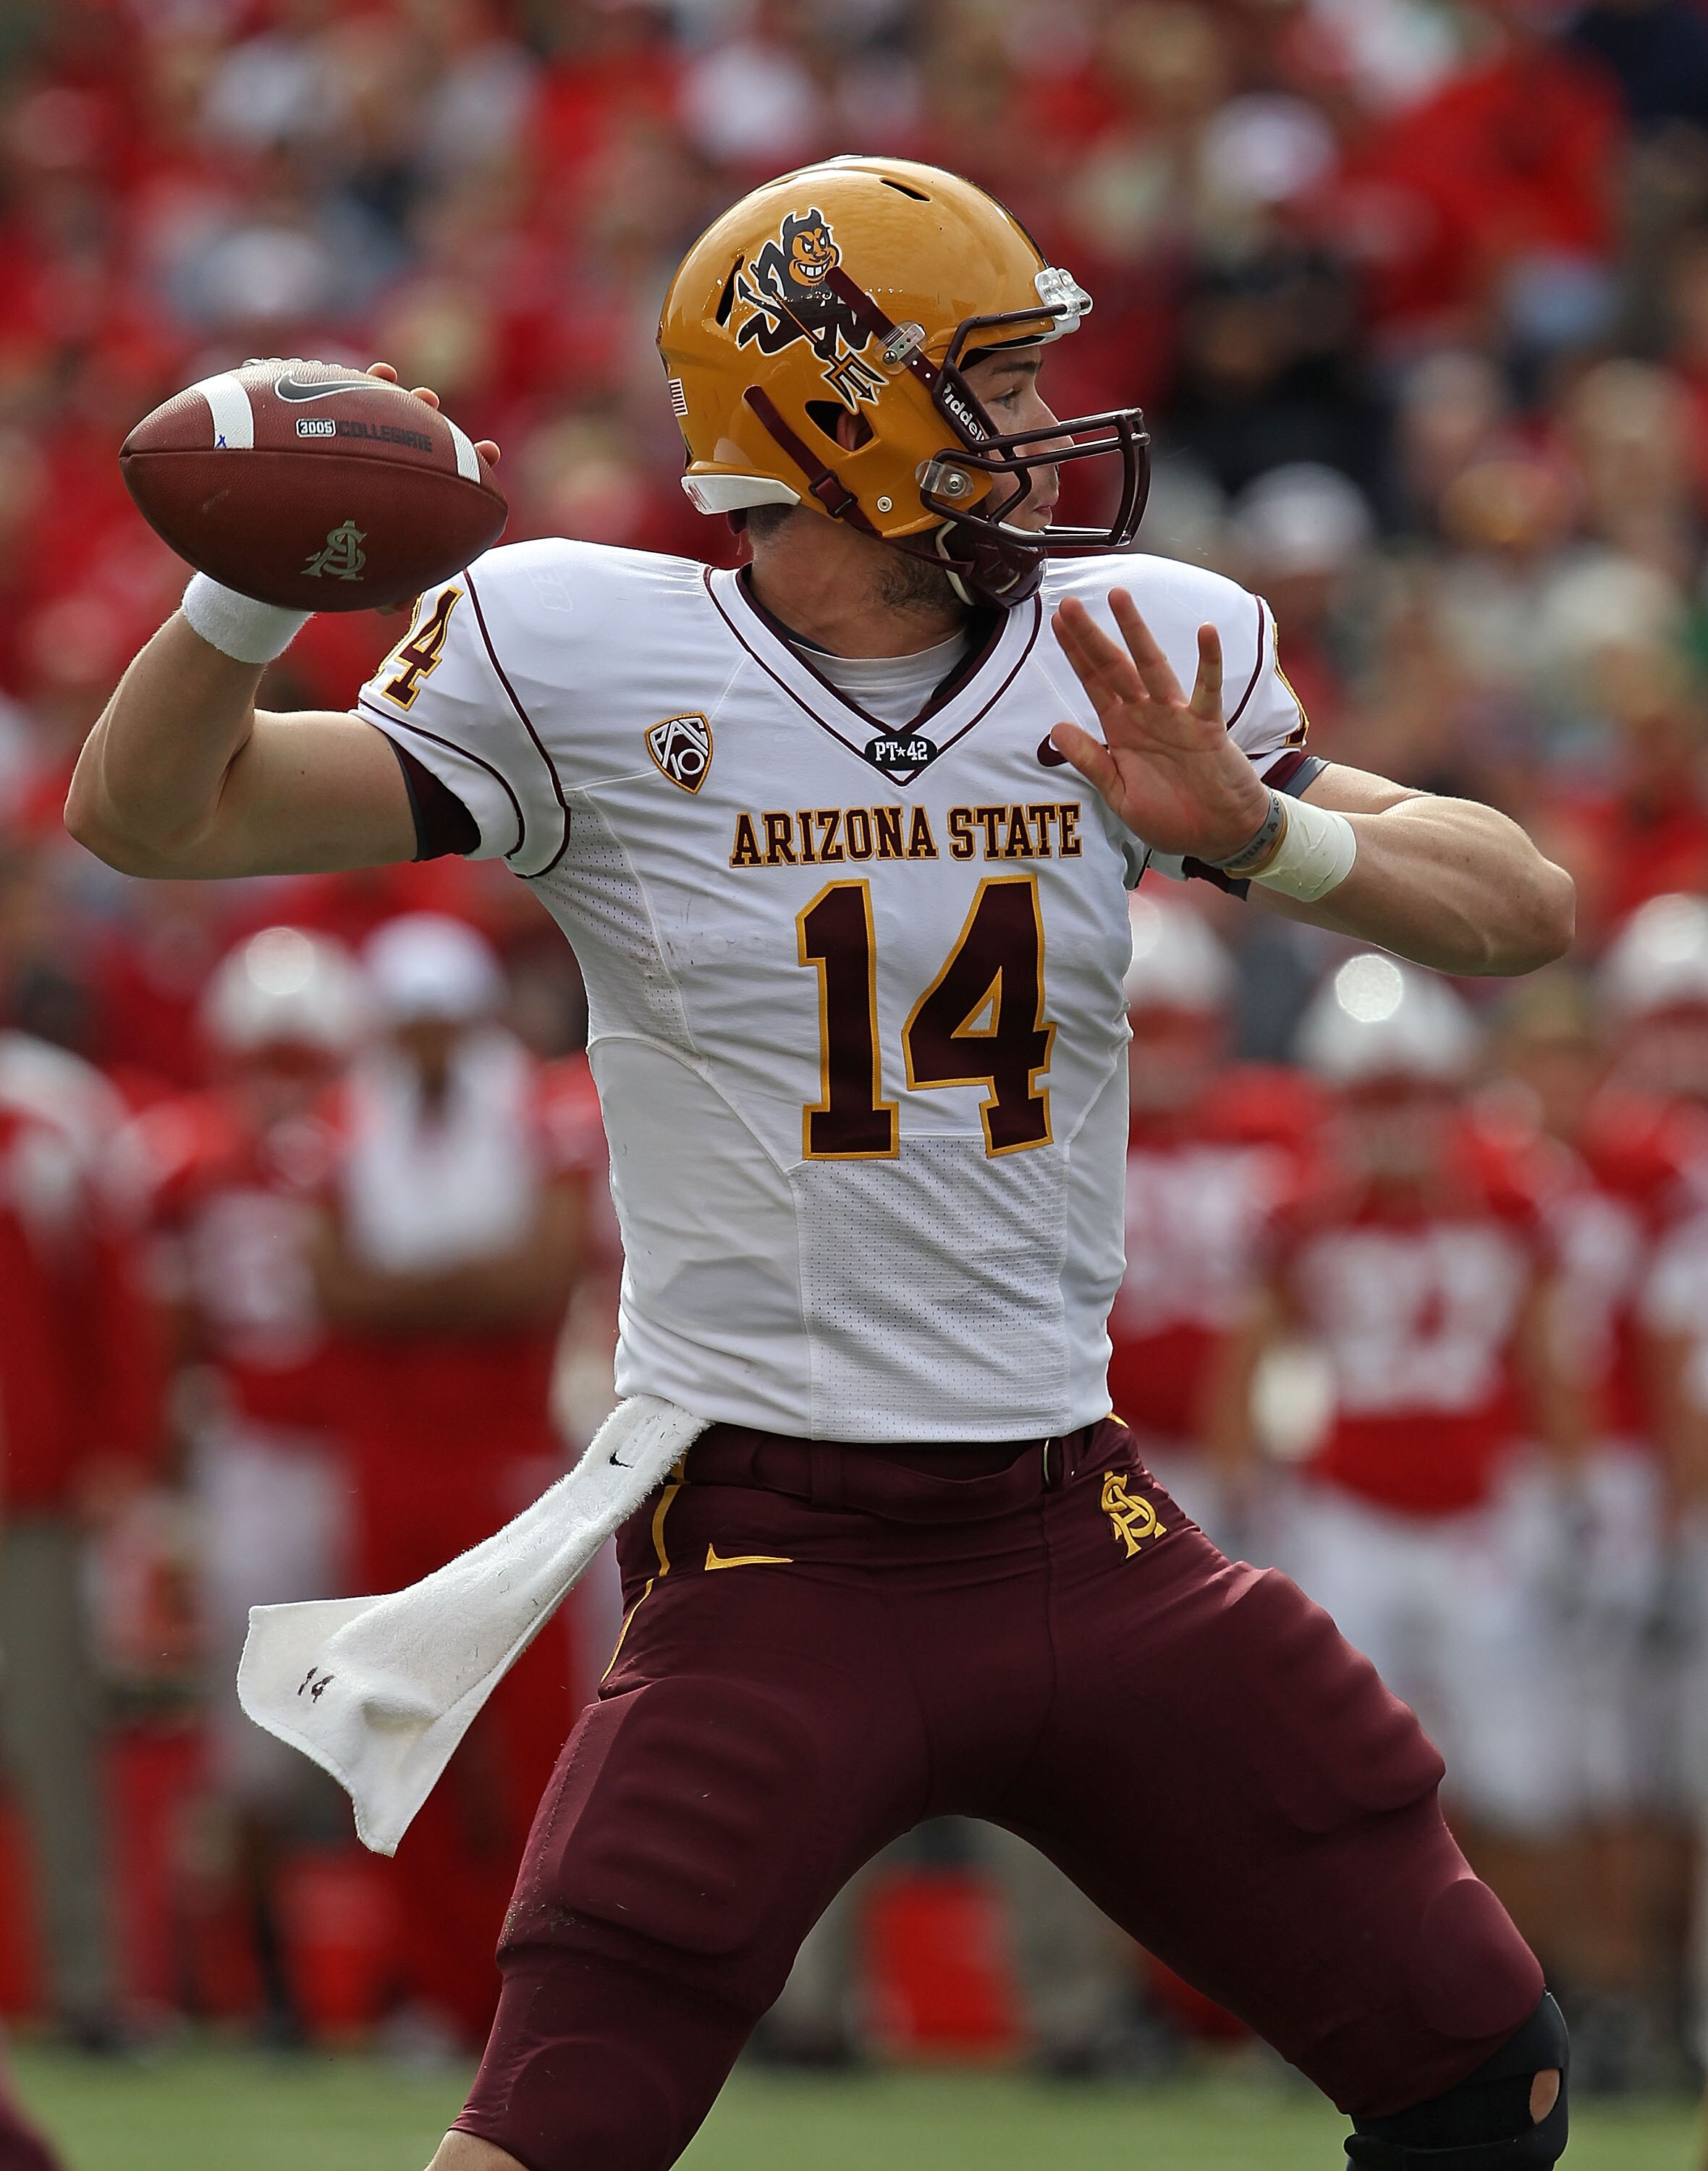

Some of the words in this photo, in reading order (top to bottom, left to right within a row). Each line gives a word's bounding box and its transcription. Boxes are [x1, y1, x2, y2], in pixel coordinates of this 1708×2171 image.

[300, 420, 334, 436] 3005
[368, 585, 464, 712] 4
[649, 717, 709, 770] PAC
[669, 748, 706, 781] 10
[729, 805, 939, 868] ARIZONA
[948, 801, 1082, 861] STATE
[795, 873, 1057, 1161] 14
